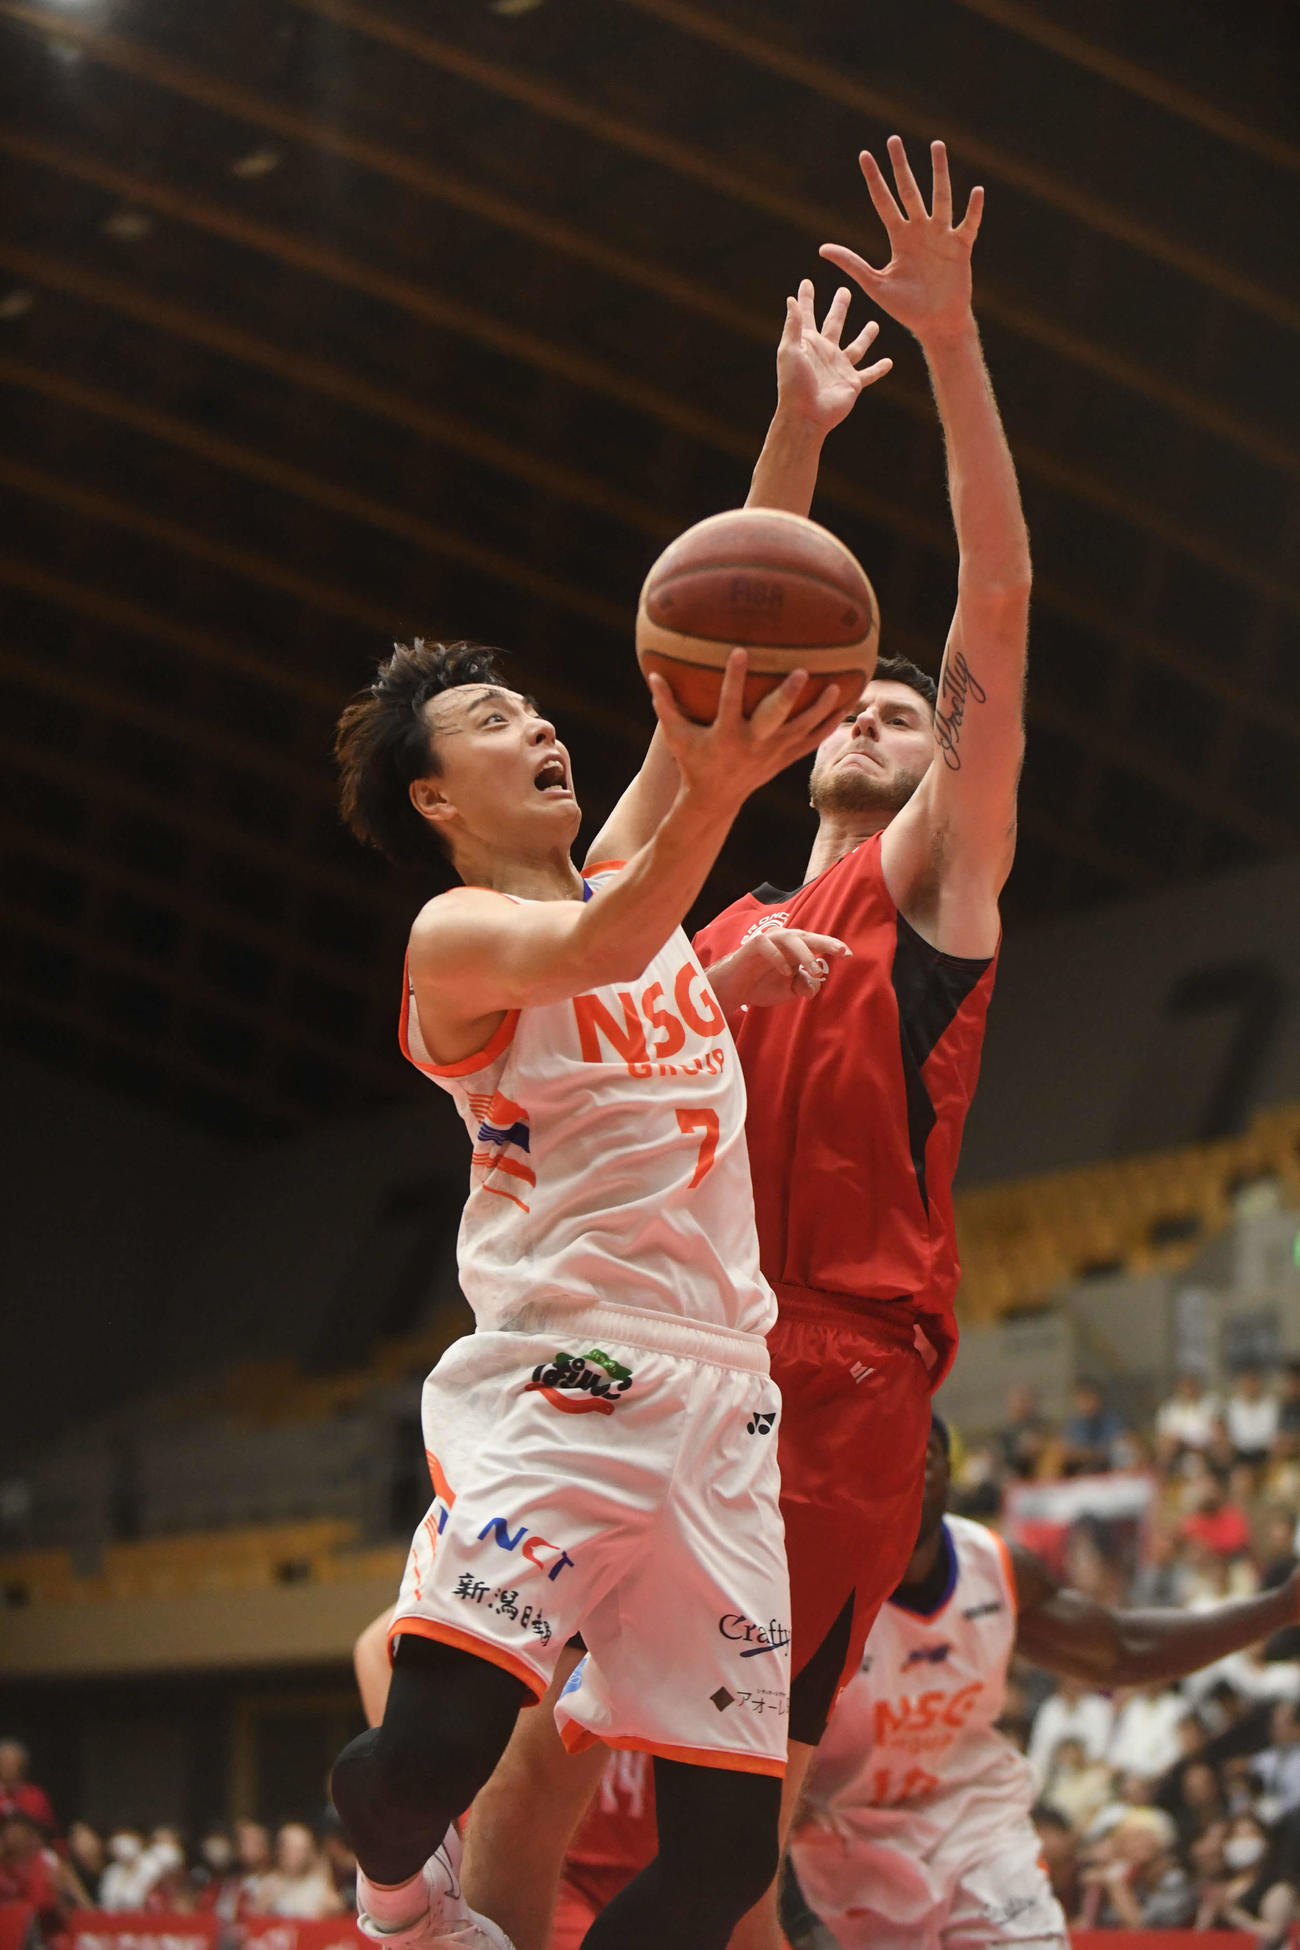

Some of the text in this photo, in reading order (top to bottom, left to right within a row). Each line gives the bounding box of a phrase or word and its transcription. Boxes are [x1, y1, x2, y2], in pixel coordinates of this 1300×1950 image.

[573, 962, 725, 1064] NSG
[675, 1108, 720, 1189] 7
[477, 1517, 575, 1581] NCT
[874, 1680, 984, 1746] NSG
